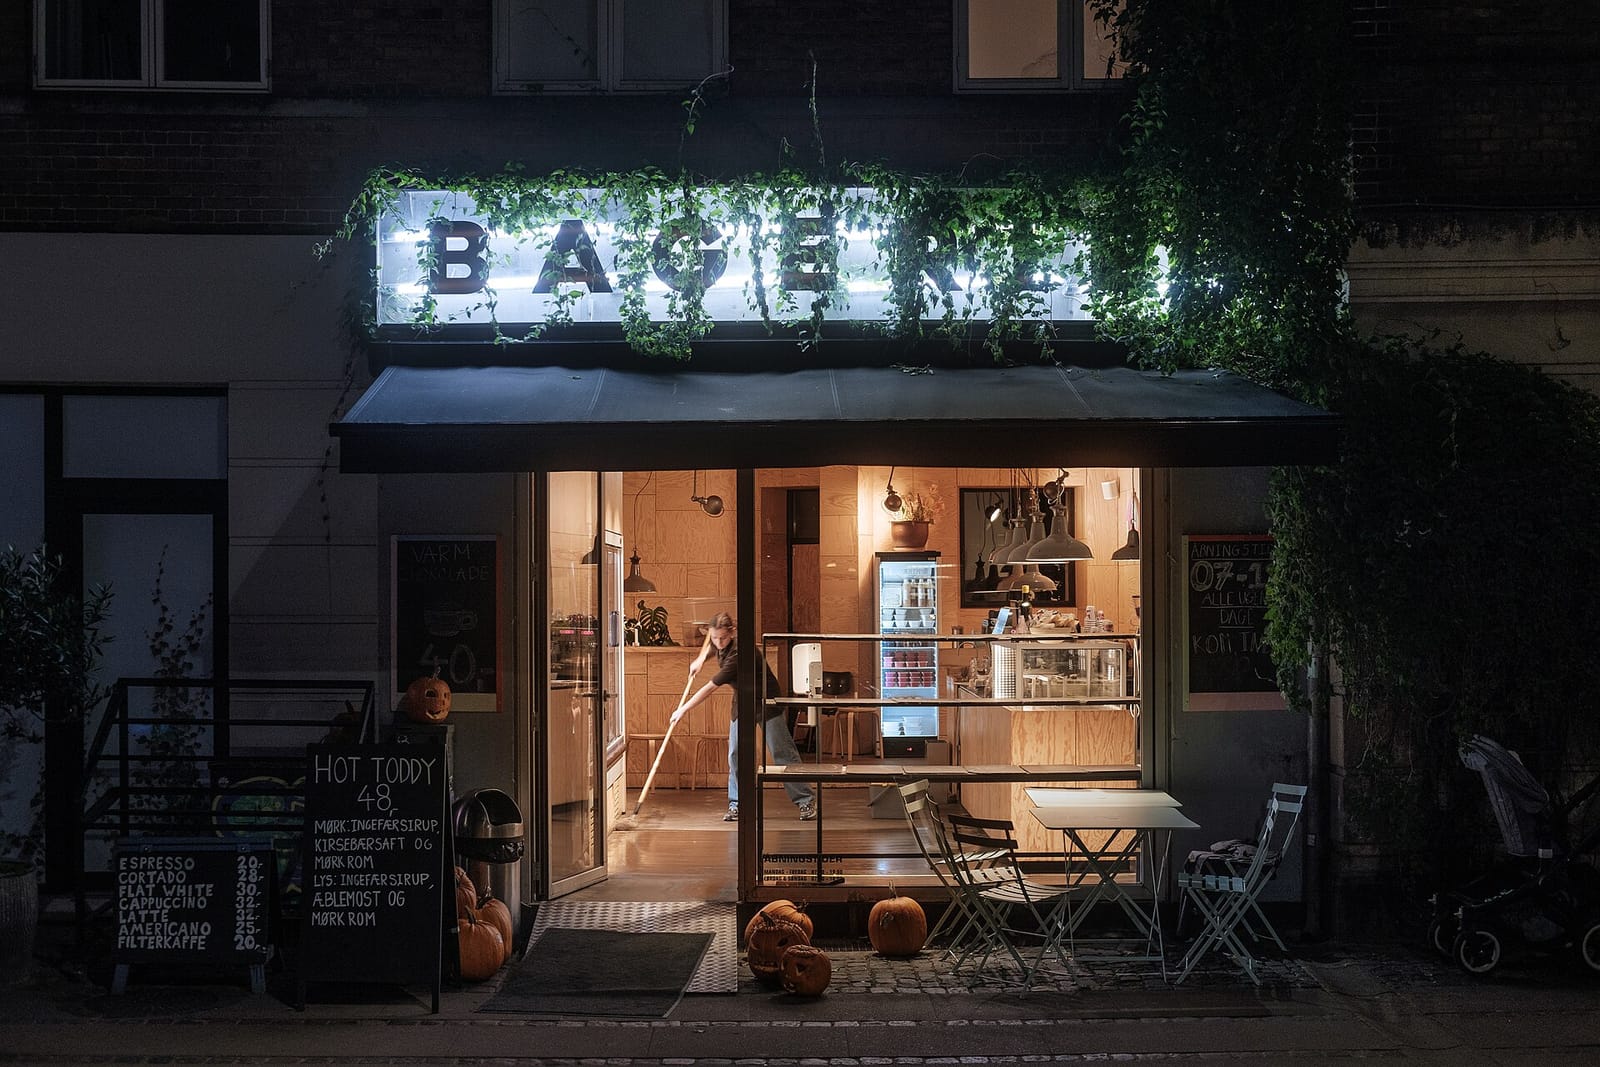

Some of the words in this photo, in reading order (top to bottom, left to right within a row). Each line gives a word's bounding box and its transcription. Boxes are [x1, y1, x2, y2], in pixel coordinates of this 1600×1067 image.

[429, 219, 1034, 294] BAGER
[410, 543, 472, 564] VARM
[399, 566, 489, 581] KOLADE
[1190, 560, 1266, 592] 07-1
[1201, 591, 1235, 606] ALLE
[315, 754, 361, 784] HOT
[370, 757, 436, 785] TODDY
[315, 837, 405, 852] KIRSEBÆRSAFT
[414, 838, 433, 850] OG
[119, 856, 195, 870] ESPRESSO
[314, 856, 345, 870] MØRK
[347, 856, 374, 869] ROM
[118, 870, 186, 884] CORTADO
[314, 874, 337, 887] LYS:
[340, 873, 434, 889] INGEFÆRSIRUP,
[119, 884, 155, 897] FLAT
[163, 883, 214, 897] WHITE
[119, 897, 207, 910] CAPPUCCINO
[313, 890, 381, 907] ÆBLEMOST
[388, 891, 405, 907] OG
[119, 909, 169, 923] LATTE
[311, 912, 345, 926] MØRK
[348, 912, 376, 926] ROM
[118, 922, 212, 936] AMERICANO
[117, 936, 206, 950] FILTERKAFFE
